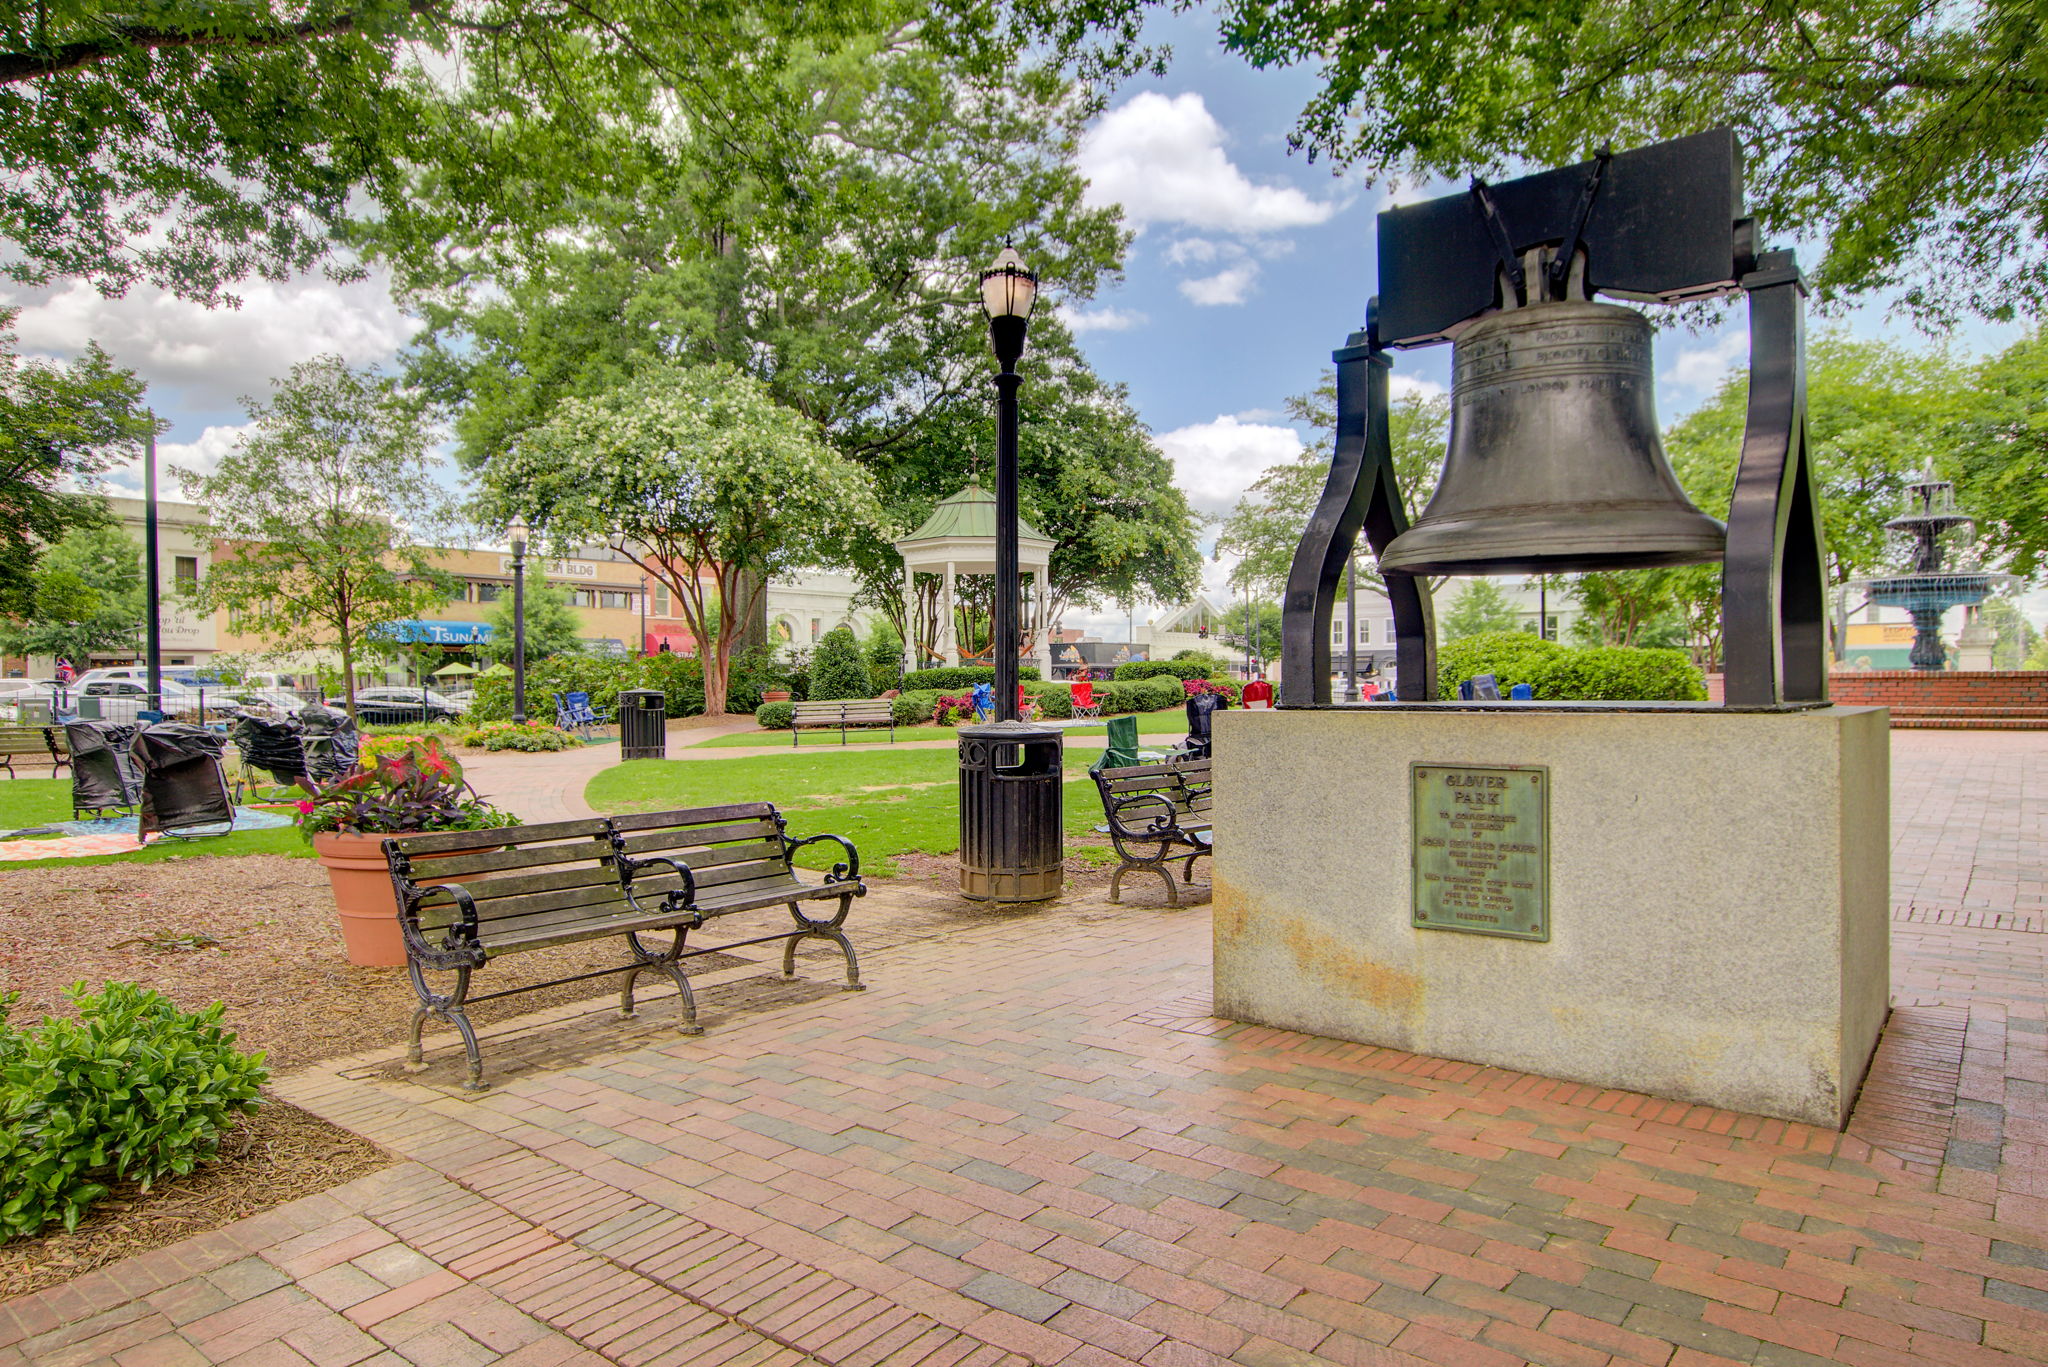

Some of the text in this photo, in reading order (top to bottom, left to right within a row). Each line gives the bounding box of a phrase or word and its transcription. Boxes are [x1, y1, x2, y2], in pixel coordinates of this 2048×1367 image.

[567, 563, 593, 576] BLDG
[1446, 775, 1508, 789] GLOVER
[1455, 791, 1500, 805] PARK
